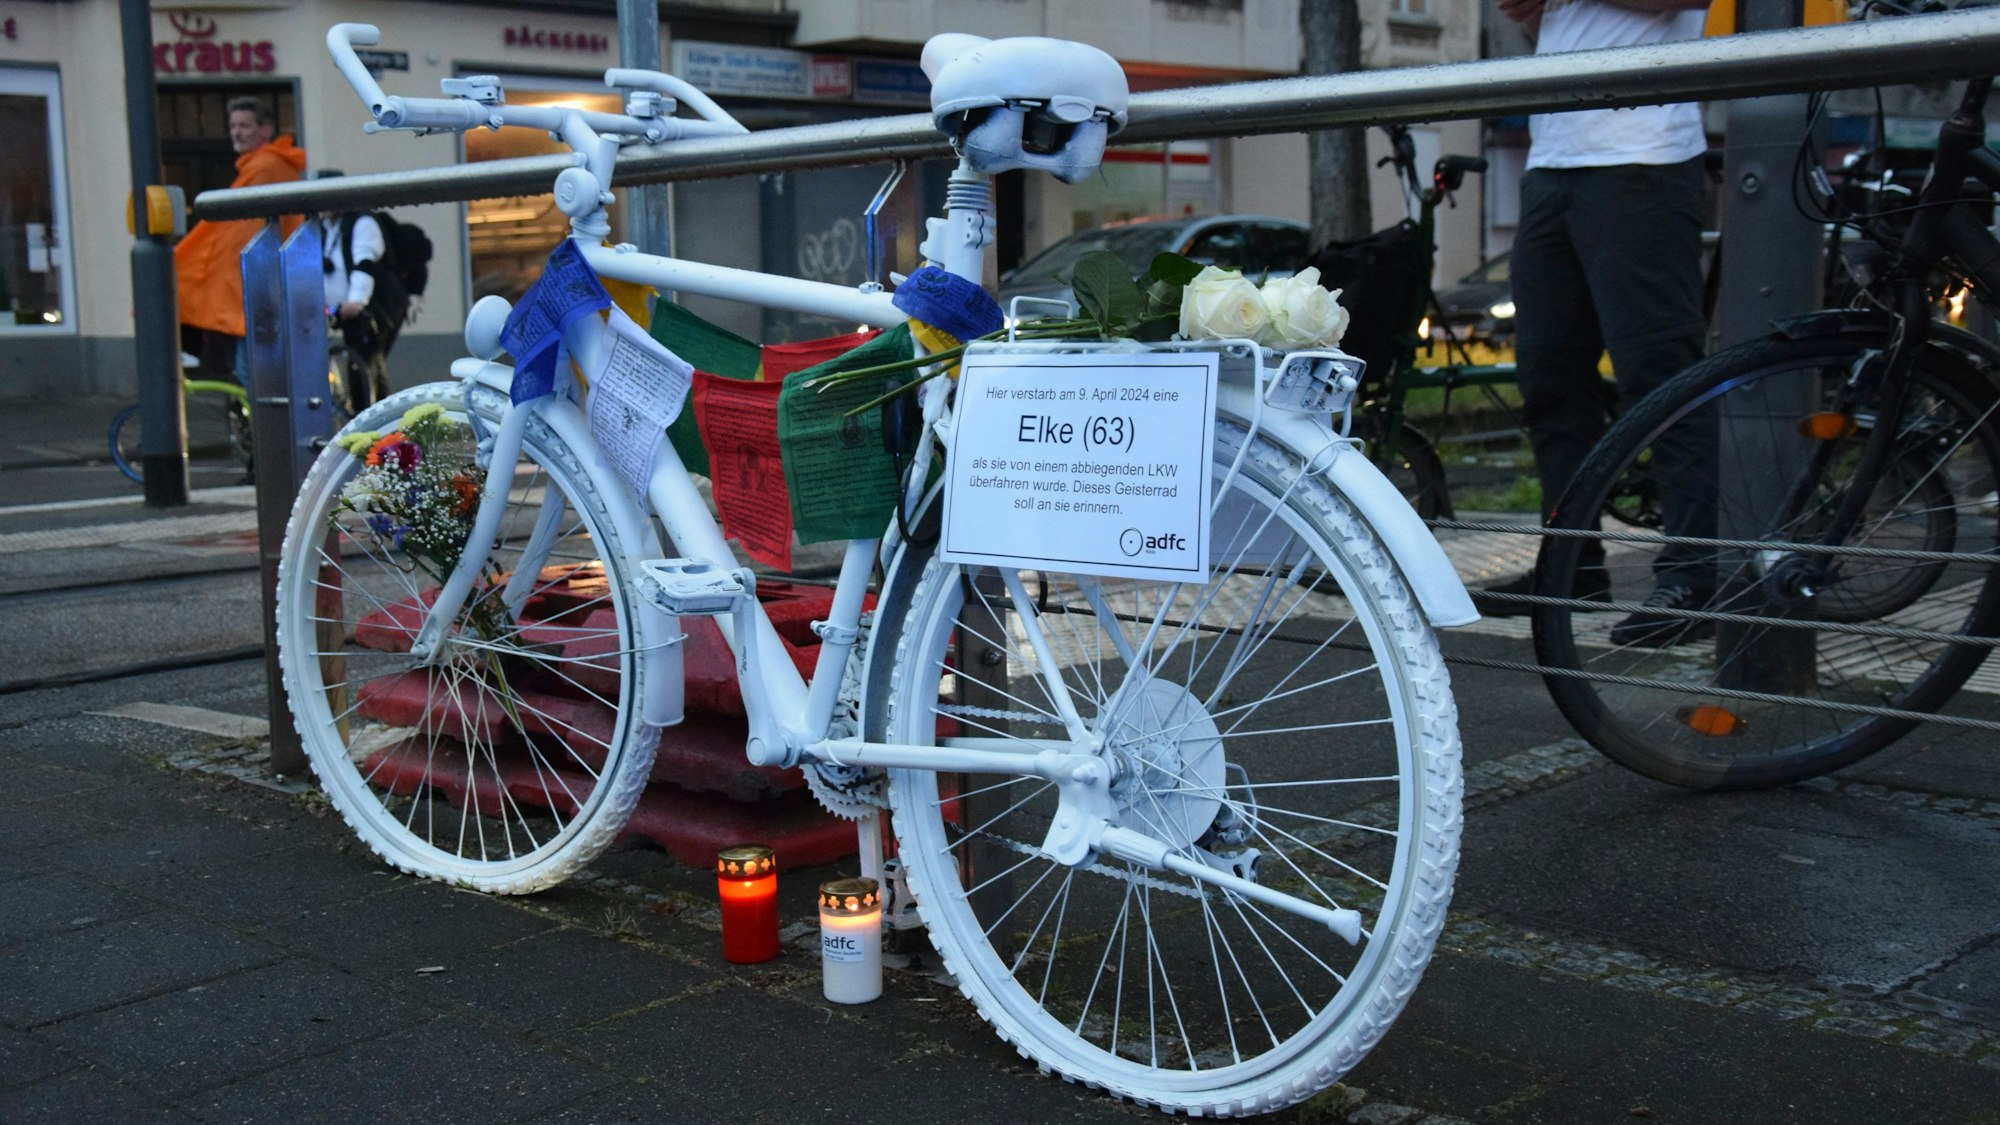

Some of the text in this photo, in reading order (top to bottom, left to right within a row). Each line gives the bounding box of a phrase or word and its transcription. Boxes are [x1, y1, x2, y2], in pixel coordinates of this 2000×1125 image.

[986, 387, 1179, 403] Hier verstarb am 9. April 2024 eine
[1018, 414, 1135, 453] Elke (63)
[972, 456, 1178, 478] als sie von einem abbiegenden LKW
[969, 475, 1178, 498] überfahren wurde. Dieses Geisterrad
[1013, 497, 1123, 515] soll an sie erinnern.
[1145, 533, 1187, 551] adfc
[824, 936, 855, 950] adfc
